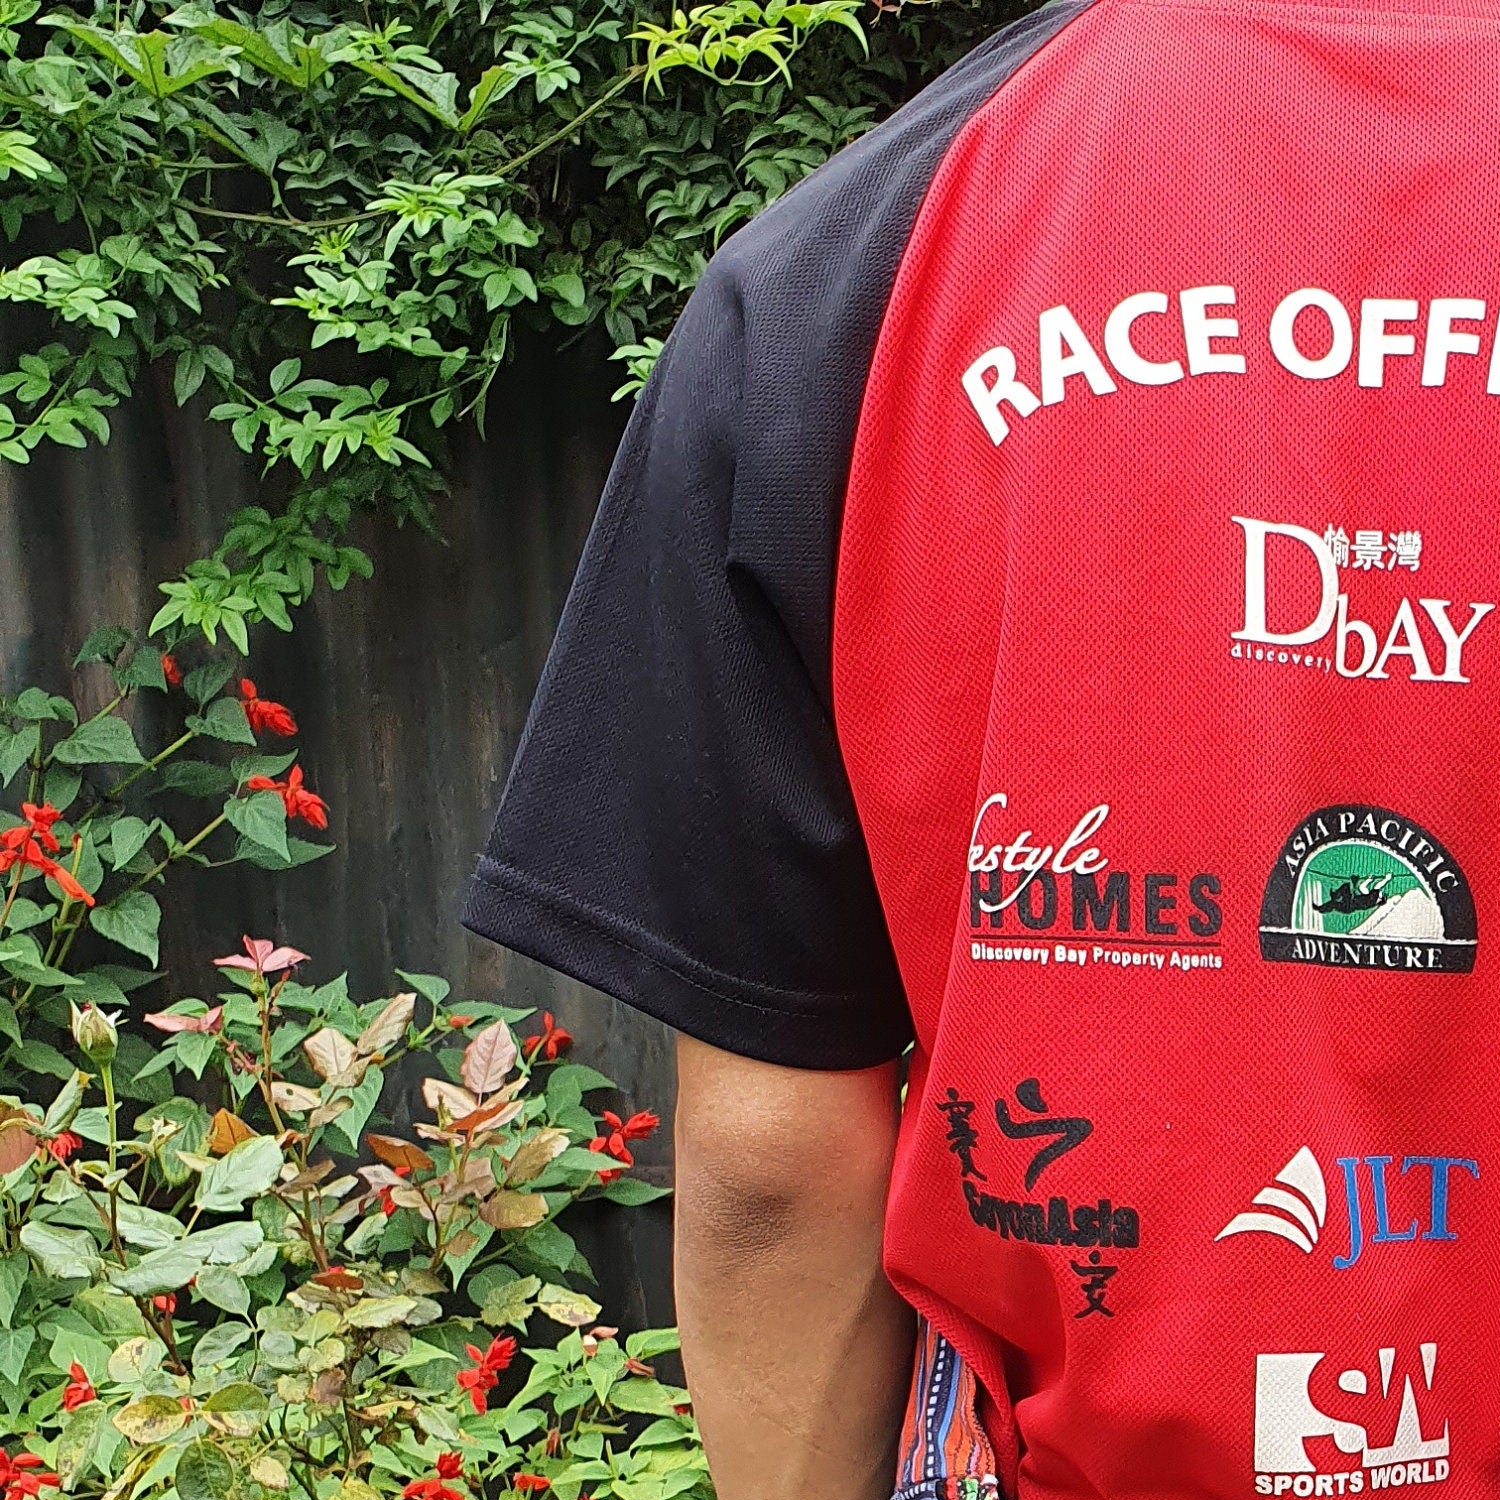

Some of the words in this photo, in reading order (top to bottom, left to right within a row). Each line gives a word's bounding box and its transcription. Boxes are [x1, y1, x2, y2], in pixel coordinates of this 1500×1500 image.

[960, 285, 1247, 446] RACE
[1230, 642, 1333, 675] discovery
[1284, 816, 1330, 879] ASIA
[1337, 811, 1462, 895] PACIFIC
[969, 868, 1223, 937] HOMES
[971, 942, 1049, 966] Discovery
[1054, 945, 1088, 966] Bay
[1093, 945, 1166, 970] Property
[1170, 950, 1224, 971] Agents
[1291, 938, 1444, 970] ADVENTURE
[1332, 1154, 1480, 1270] JLT
[1254, 1470, 1364, 1497] SPORTS
[1370, 1459, 1450, 1490] WORLD
